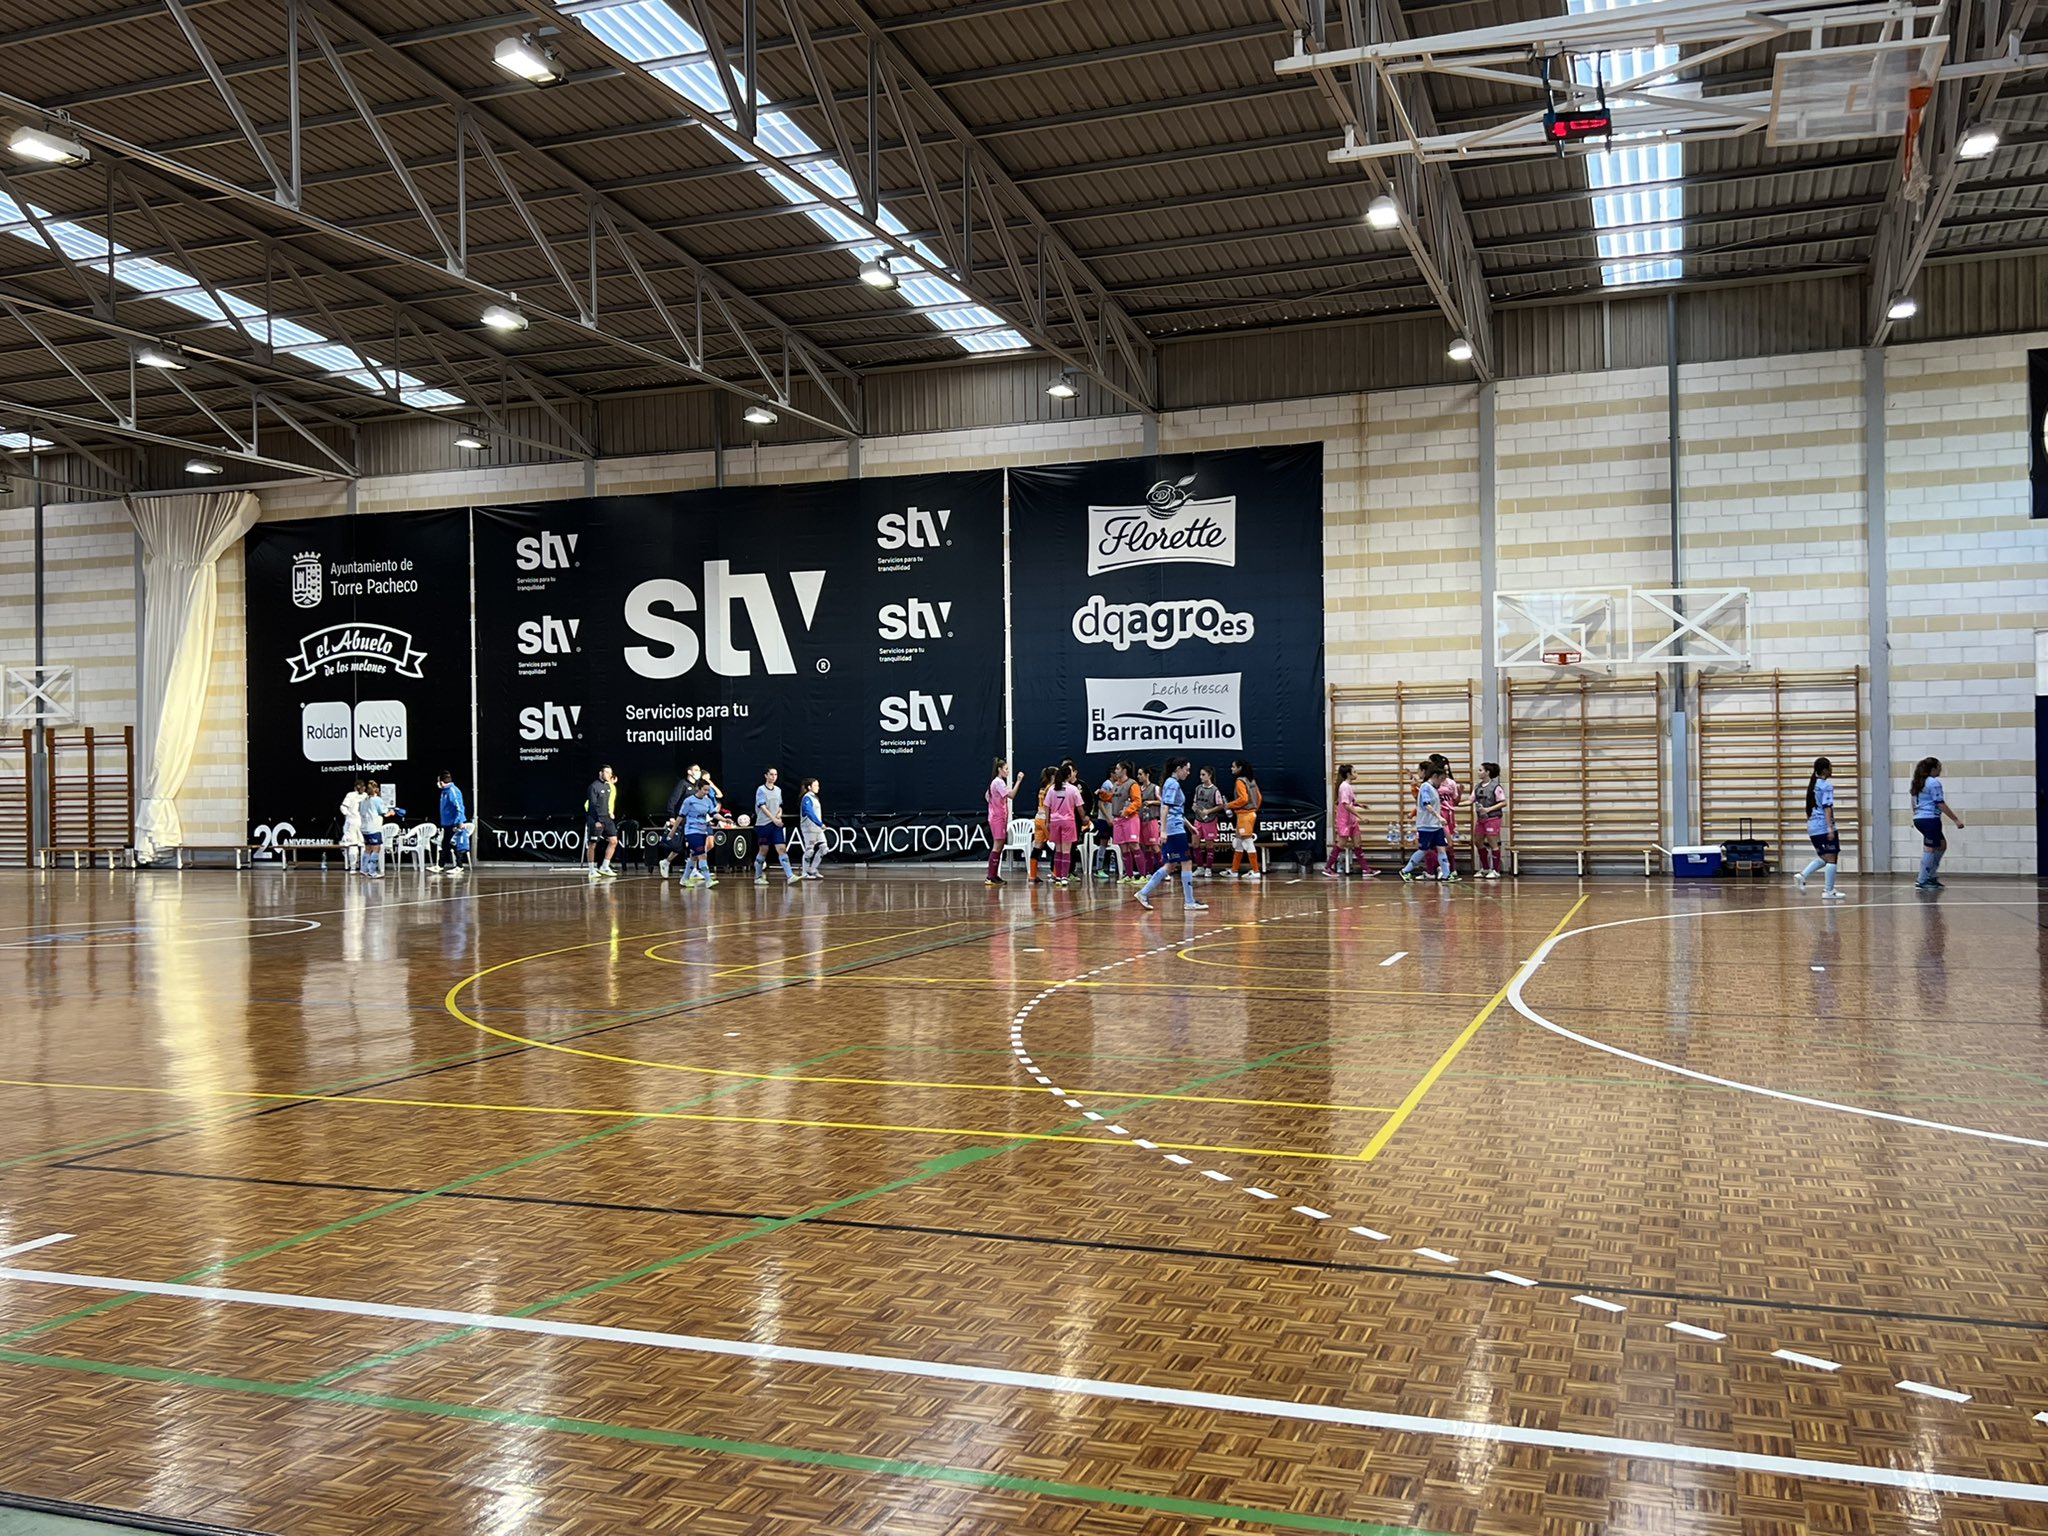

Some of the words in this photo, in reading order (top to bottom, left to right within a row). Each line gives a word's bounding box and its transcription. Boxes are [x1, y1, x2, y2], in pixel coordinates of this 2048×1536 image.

[1098, 516, 1227, 555] Florette
[330, 560, 398, 577] Ayuntamiento
[401, 557, 413, 571] de
[331, 580, 363, 596] Torre
[367, 577, 418, 594] Pacheco
[1079, 602, 1247, 644] dqagro.es
[316, 635, 330, 658] el
[331, 629, 393, 654] Abuelo
[324, 664, 335, 677] de
[336, 660, 349, 674] los
[351, 659, 387, 674] melones
[1151, 682, 1188, 696] Leche
[1192, 681, 1229, 695] fresca
[625, 704, 694, 720] Servicios
[697, 705, 729, 722] para
[732, 702, 749, 717] tu
[1091, 708, 1105, 722] El
[306, 723, 348, 740] Roldan
[359, 723, 403, 743] Netya
[625, 725, 713, 746] tranquilidad
[1091, 719, 1236, 744] Barranquillo
[1056, 796, 1066, 812] 7
[1259, 820, 1316, 832] ESFUERZO
[1272, 829, 1316, 841] ILUSIÓN
[492, 830, 519, 849] TU
[520, 830, 580, 849] APOYO
[782, 826, 857, 853] AOR
[862, 824, 990, 853] VICTORIA
